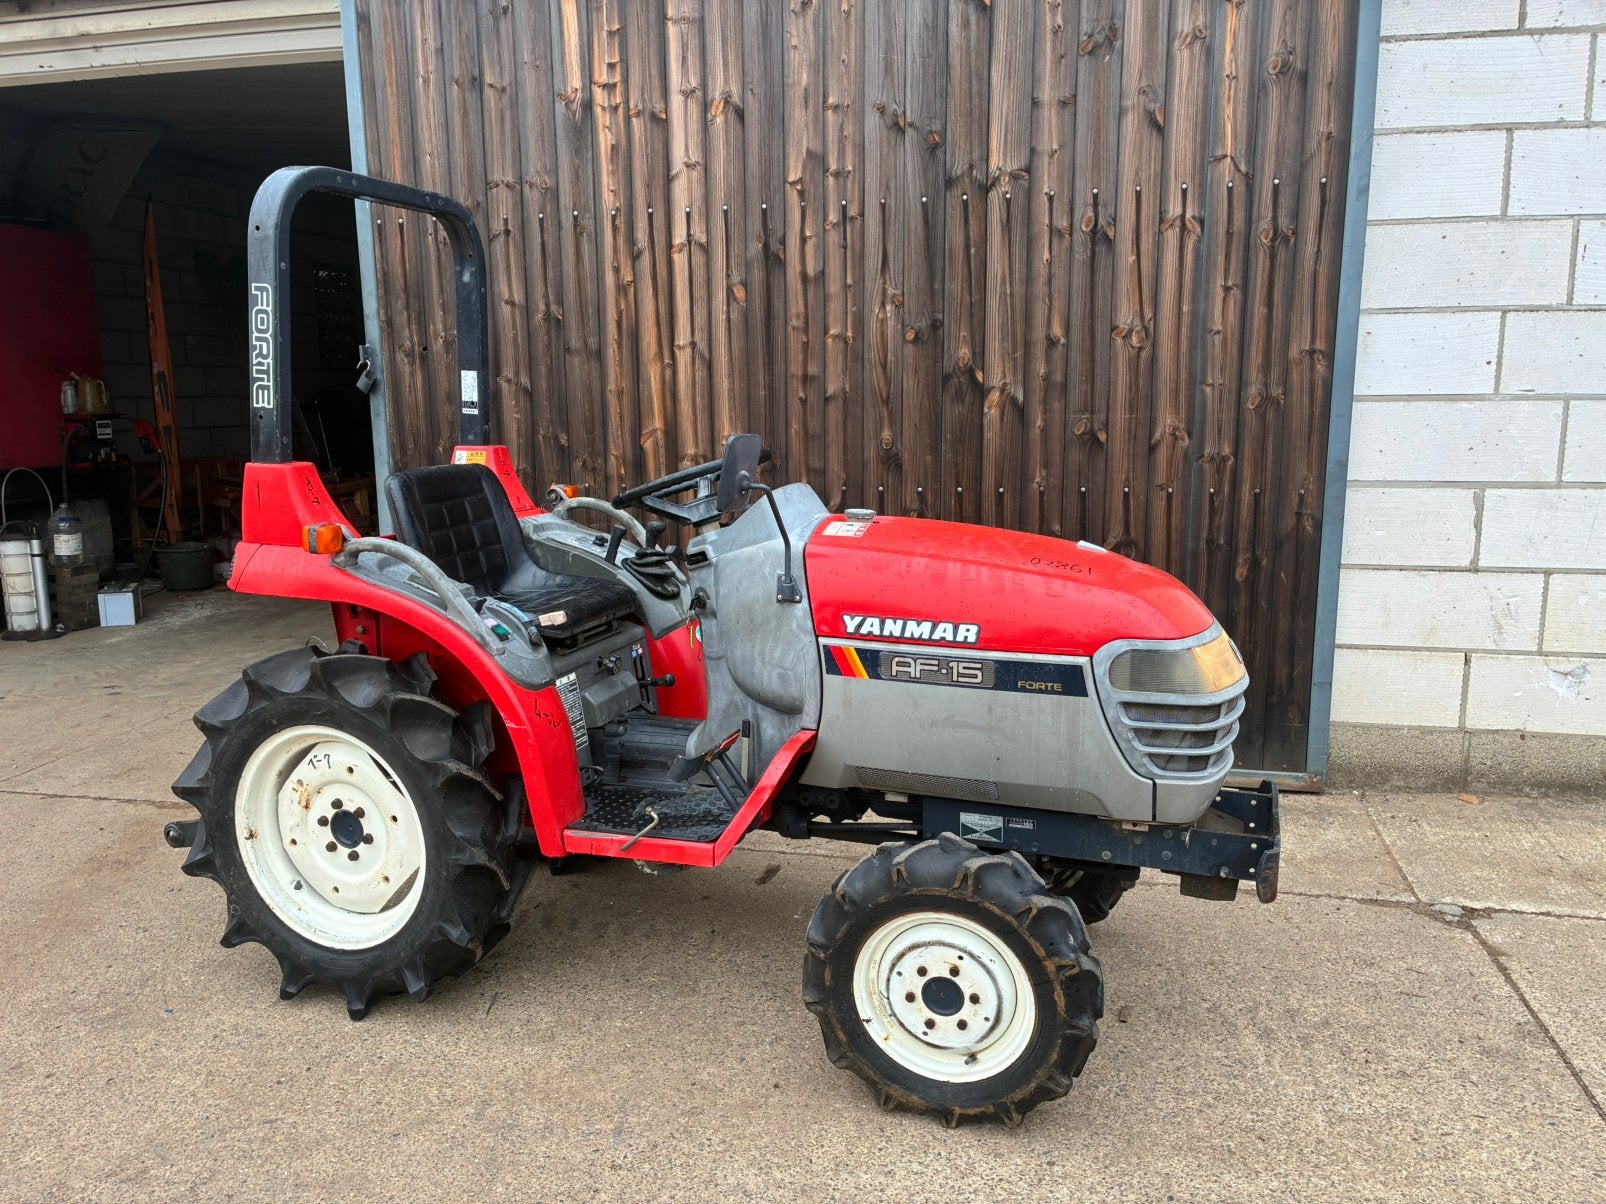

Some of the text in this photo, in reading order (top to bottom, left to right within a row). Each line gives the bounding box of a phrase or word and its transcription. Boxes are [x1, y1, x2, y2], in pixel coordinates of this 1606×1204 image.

[252, 283, 274, 408] FORTE
[842, 614, 982, 645] YANMAR
[1018, 680, 1063, 692] FORTE
